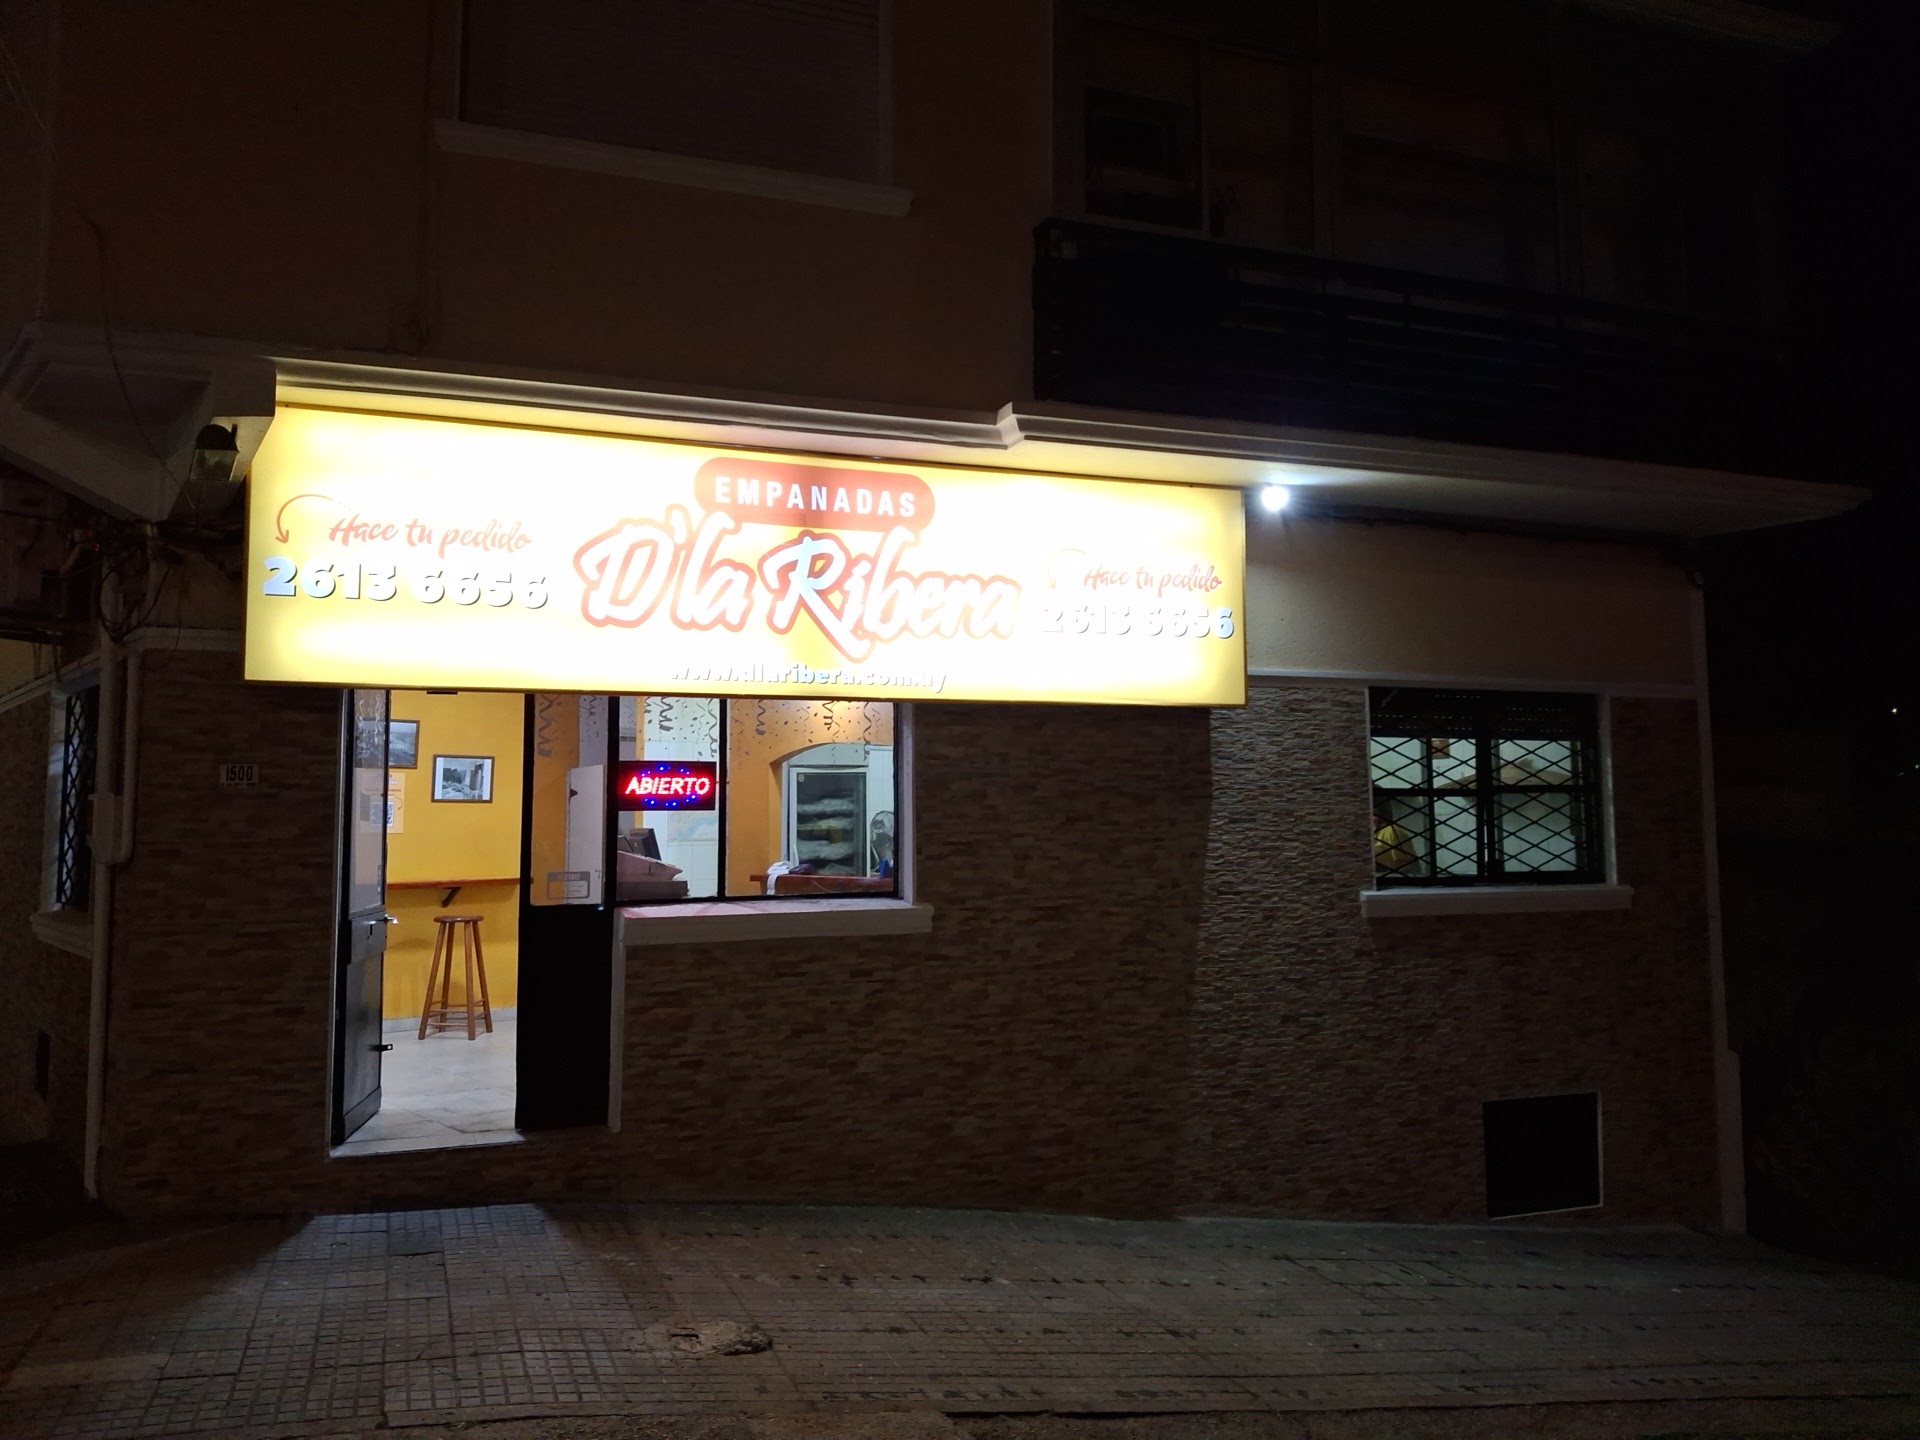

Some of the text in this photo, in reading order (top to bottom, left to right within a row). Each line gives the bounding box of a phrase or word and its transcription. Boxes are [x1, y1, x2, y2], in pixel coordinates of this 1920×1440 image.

[714, 475, 917, 518] EMPANADAS
[328, 513, 532, 559] Hace tu pedido
[262, 556, 549, 610] 2613 6656
[757, 527, 1022, 664] Ribera
[1083, 562, 1222, 599] Hace tu pedido
[624, 776, 711, 796] ABIERTO
